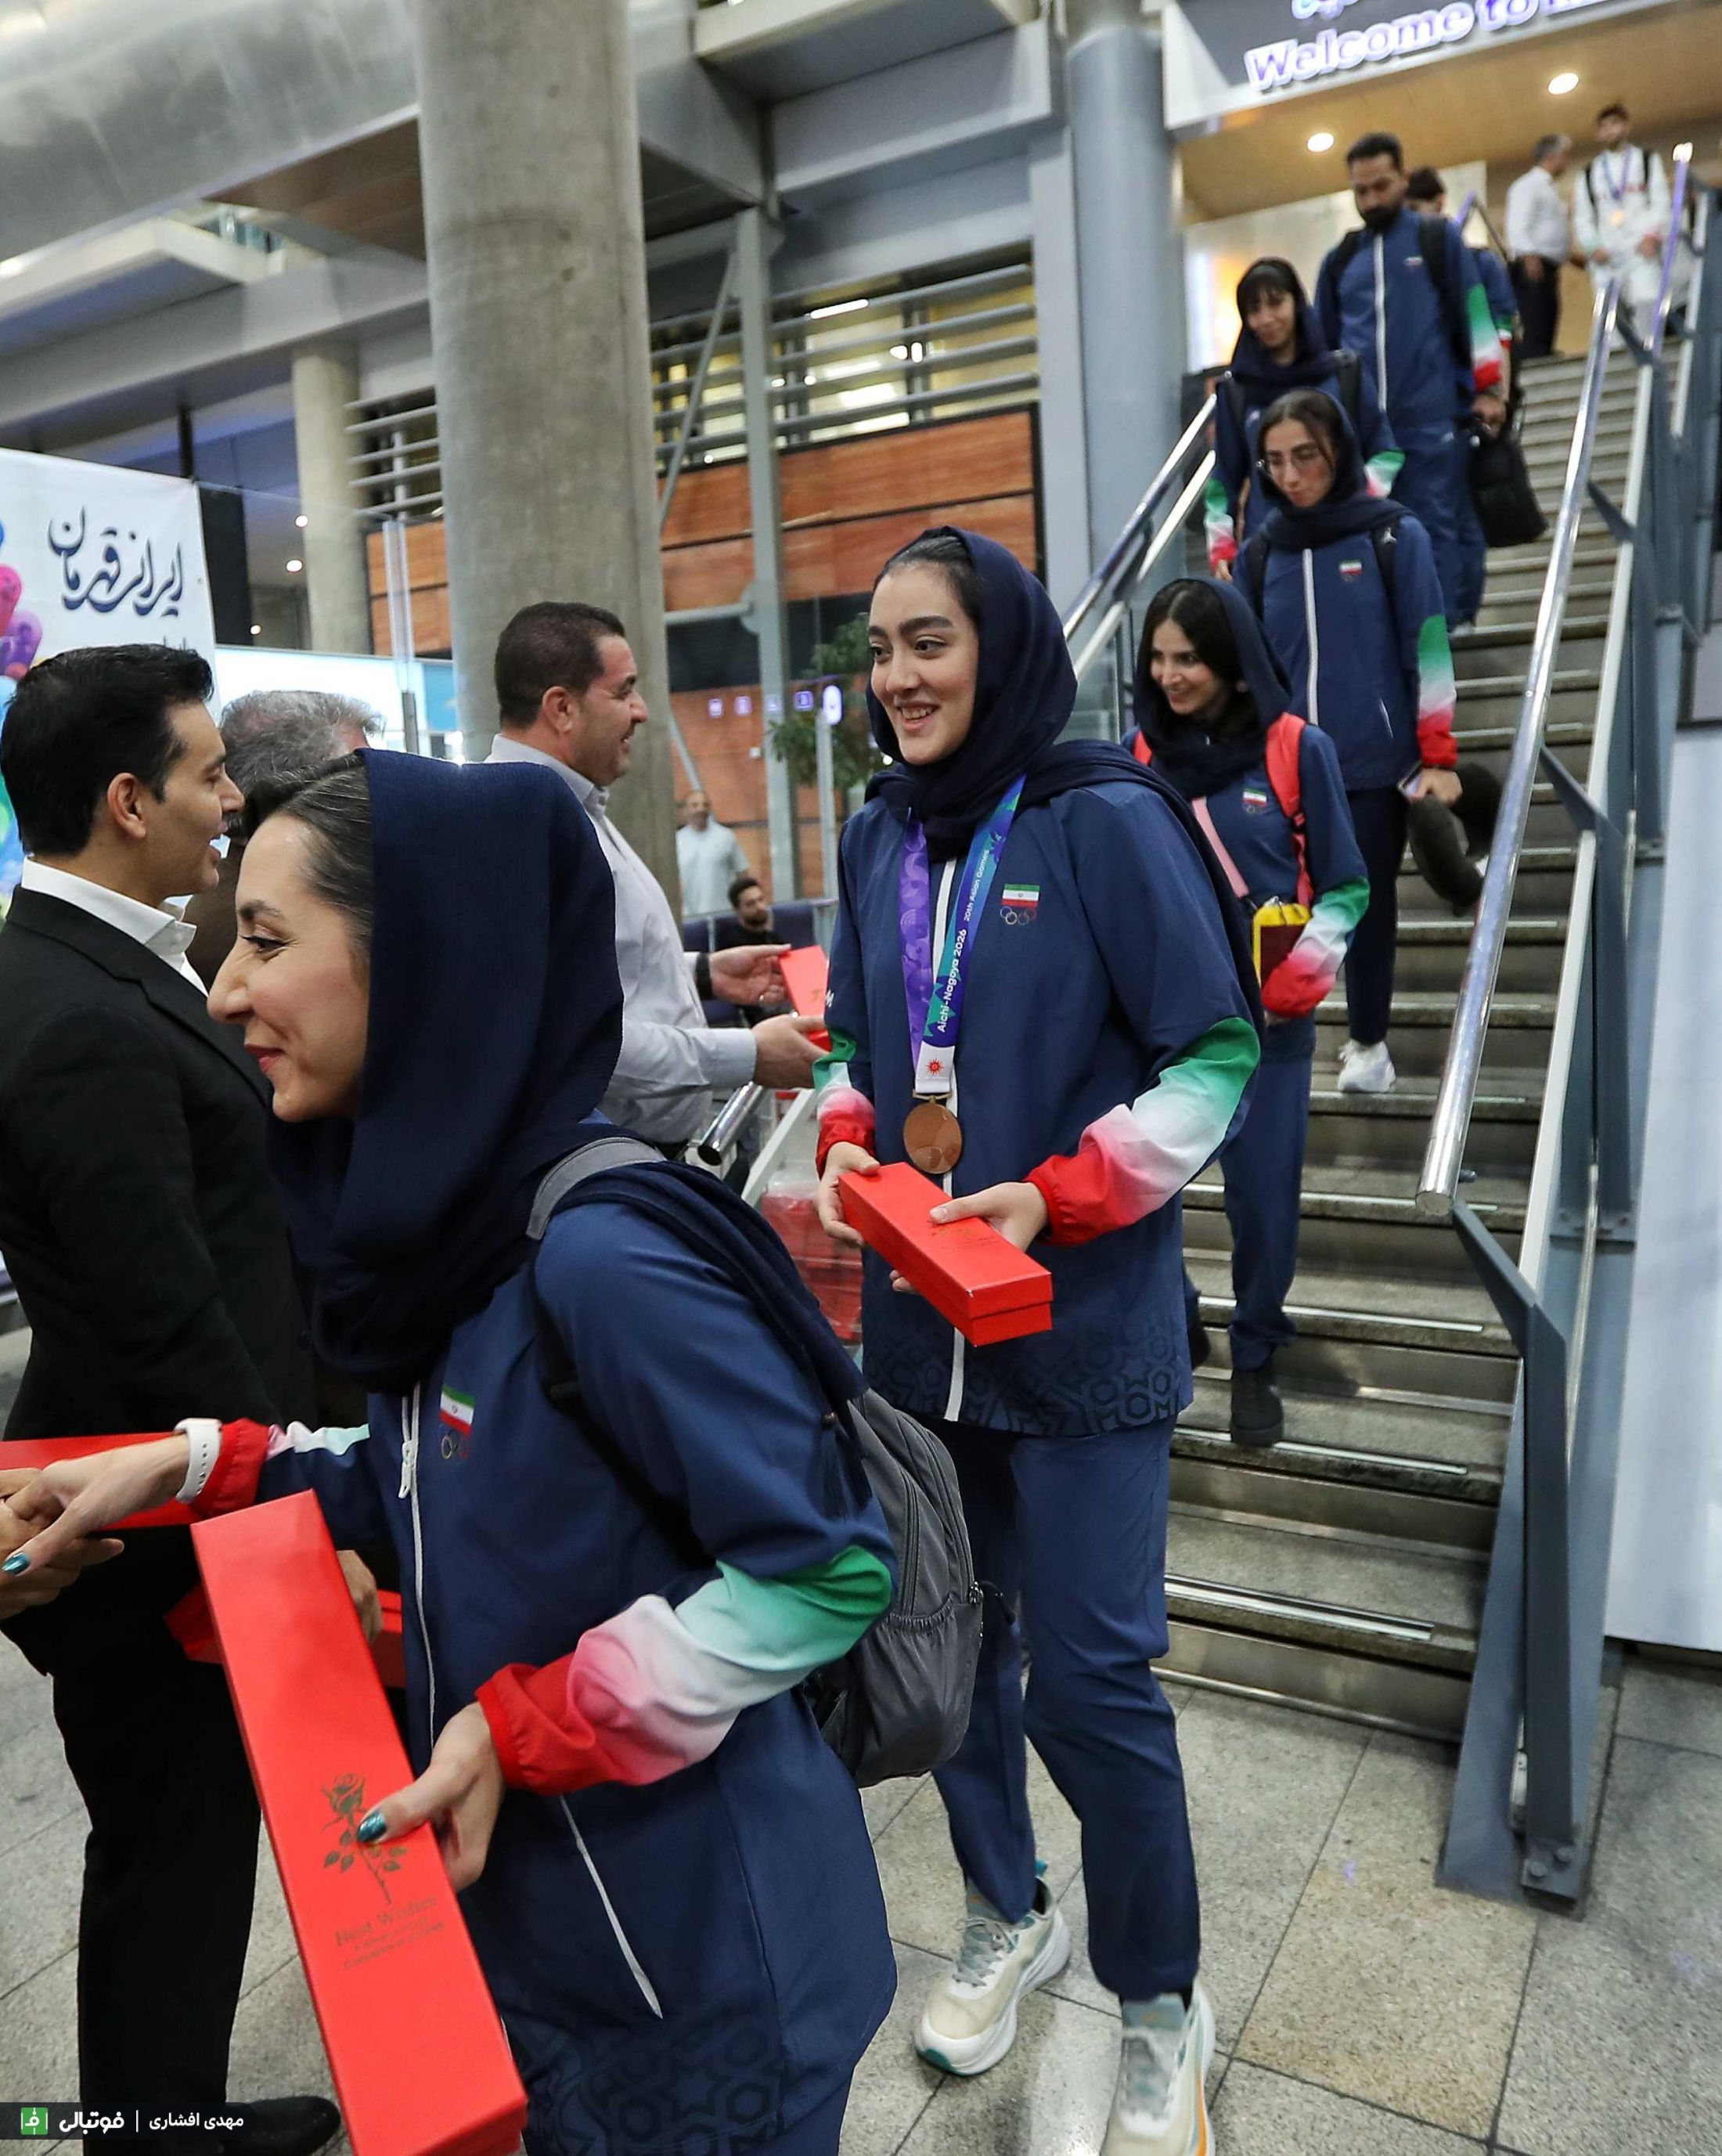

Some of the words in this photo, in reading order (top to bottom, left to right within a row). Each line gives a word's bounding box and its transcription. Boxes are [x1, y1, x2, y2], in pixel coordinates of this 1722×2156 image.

[1244, 2, 1475, 91] Welcome
[1476, 0, 1539, 31] to
[47, 505, 121, 611] قهرمان
[87, 531, 182, 616] ایران
[964, 902, 974, 921] 20th
[969, 878, 981, 902] Asian
[976, 849, 990, 878] Games
[937, 958, 960, 1033] Aichi-Nagoya
[953, 928, 967, 957] 2026
